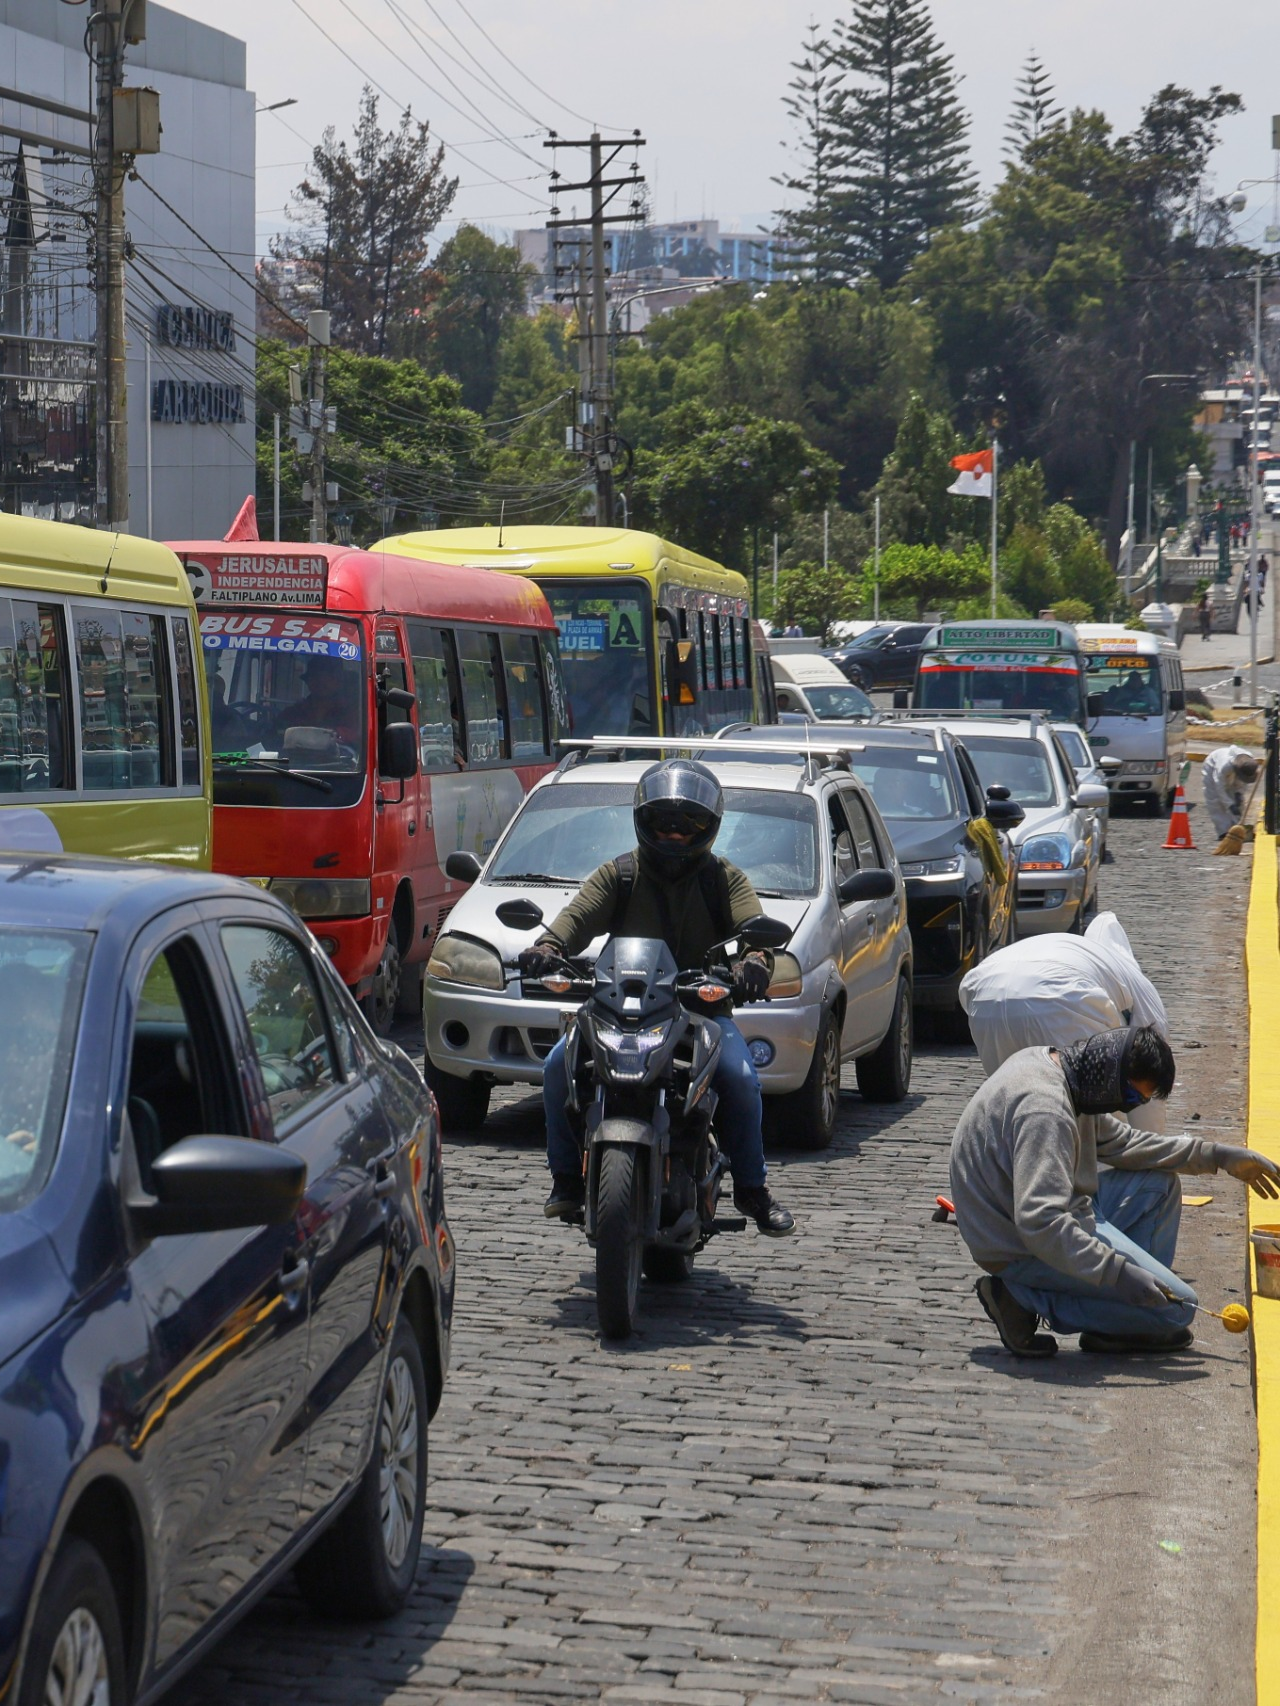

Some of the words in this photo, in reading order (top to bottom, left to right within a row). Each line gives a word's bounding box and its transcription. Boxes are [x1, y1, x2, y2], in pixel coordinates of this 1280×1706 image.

[159, 380, 246, 424] AREQUIPA
[217, 556, 323, 575] JERUSALEN
[218, 576, 323, 589] INDEPENDENCIA
[211, 590, 278, 602] F.ALTIPLANO
[281, 592, 321, 603] Av.LIMA
[200, 616, 275, 635] BUS
[281, 619, 349, 642] S.A.
[611, 612, 640, 645] A
[949, 631, 982, 639] ALTO
[986, 631, 1050, 639] LIBERTAD
[228, 636, 329, 655] MELGAR
[340, 644, 356, 657] 20
[955, 653, 1038, 664] COTUM
